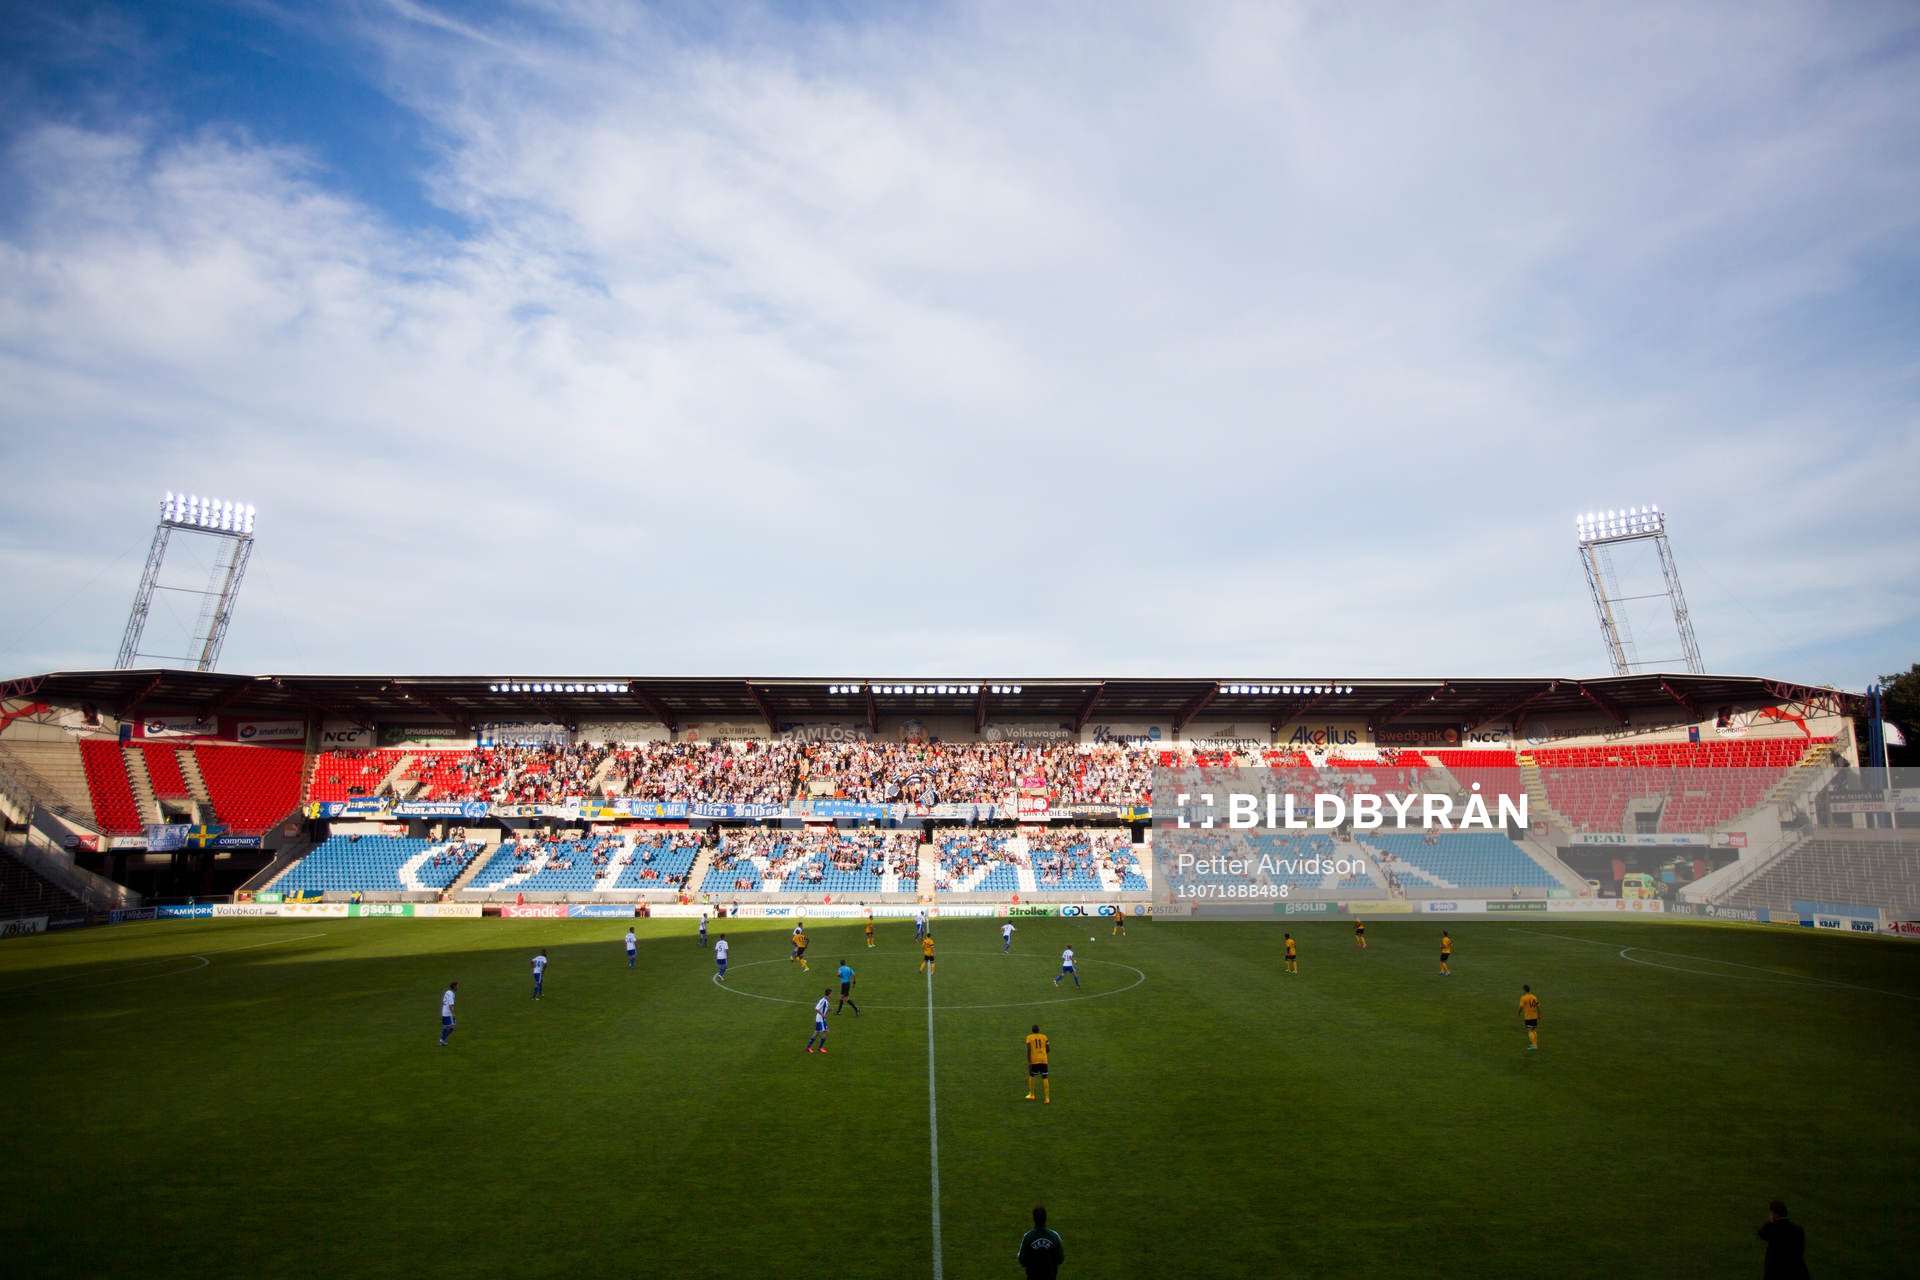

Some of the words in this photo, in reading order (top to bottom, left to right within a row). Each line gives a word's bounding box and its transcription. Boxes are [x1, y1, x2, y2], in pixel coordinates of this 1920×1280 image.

[404, 728, 456, 736] SPARBANKEN
[719, 727, 756, 735] OLYMPIA
[782, 725, 867, 742] RAMLÖSA
[1005, 728, 1069, 739] Volkswagen
[1288, 725, 1358, 745] Akelius
[1379, 729, 1441, 742] Swedbank
[324, 731, 357, 742] NCC
[1470, 733, 1501, 743] NCC
[1190, 738, 1261, 748] NORRPORTEN
[632, 803, 653, 816] WISE
[666, 803, 686, 817] MEN
[219, 838, 255, 846] company
[1583, 835, 1627, 843] PEAB
[370, 905, 404, 914] SOLID
[438, 907, 474, 915] POSTEN!
[510, 905, 561, 917] Scandic
[1010, 907, 1048, 916] Stroller
[1294, 903, 1327, 911] SOLID
[739, 908, 791, 917] INTERSPORT
[1715, 907, 1757, 921] ANEBYHUS
[1819, 920, 1840, 929] KRAFT
[1851, 923, 1874, 932] KRAFT
[1034, 1038, 1042, 1049] 11
